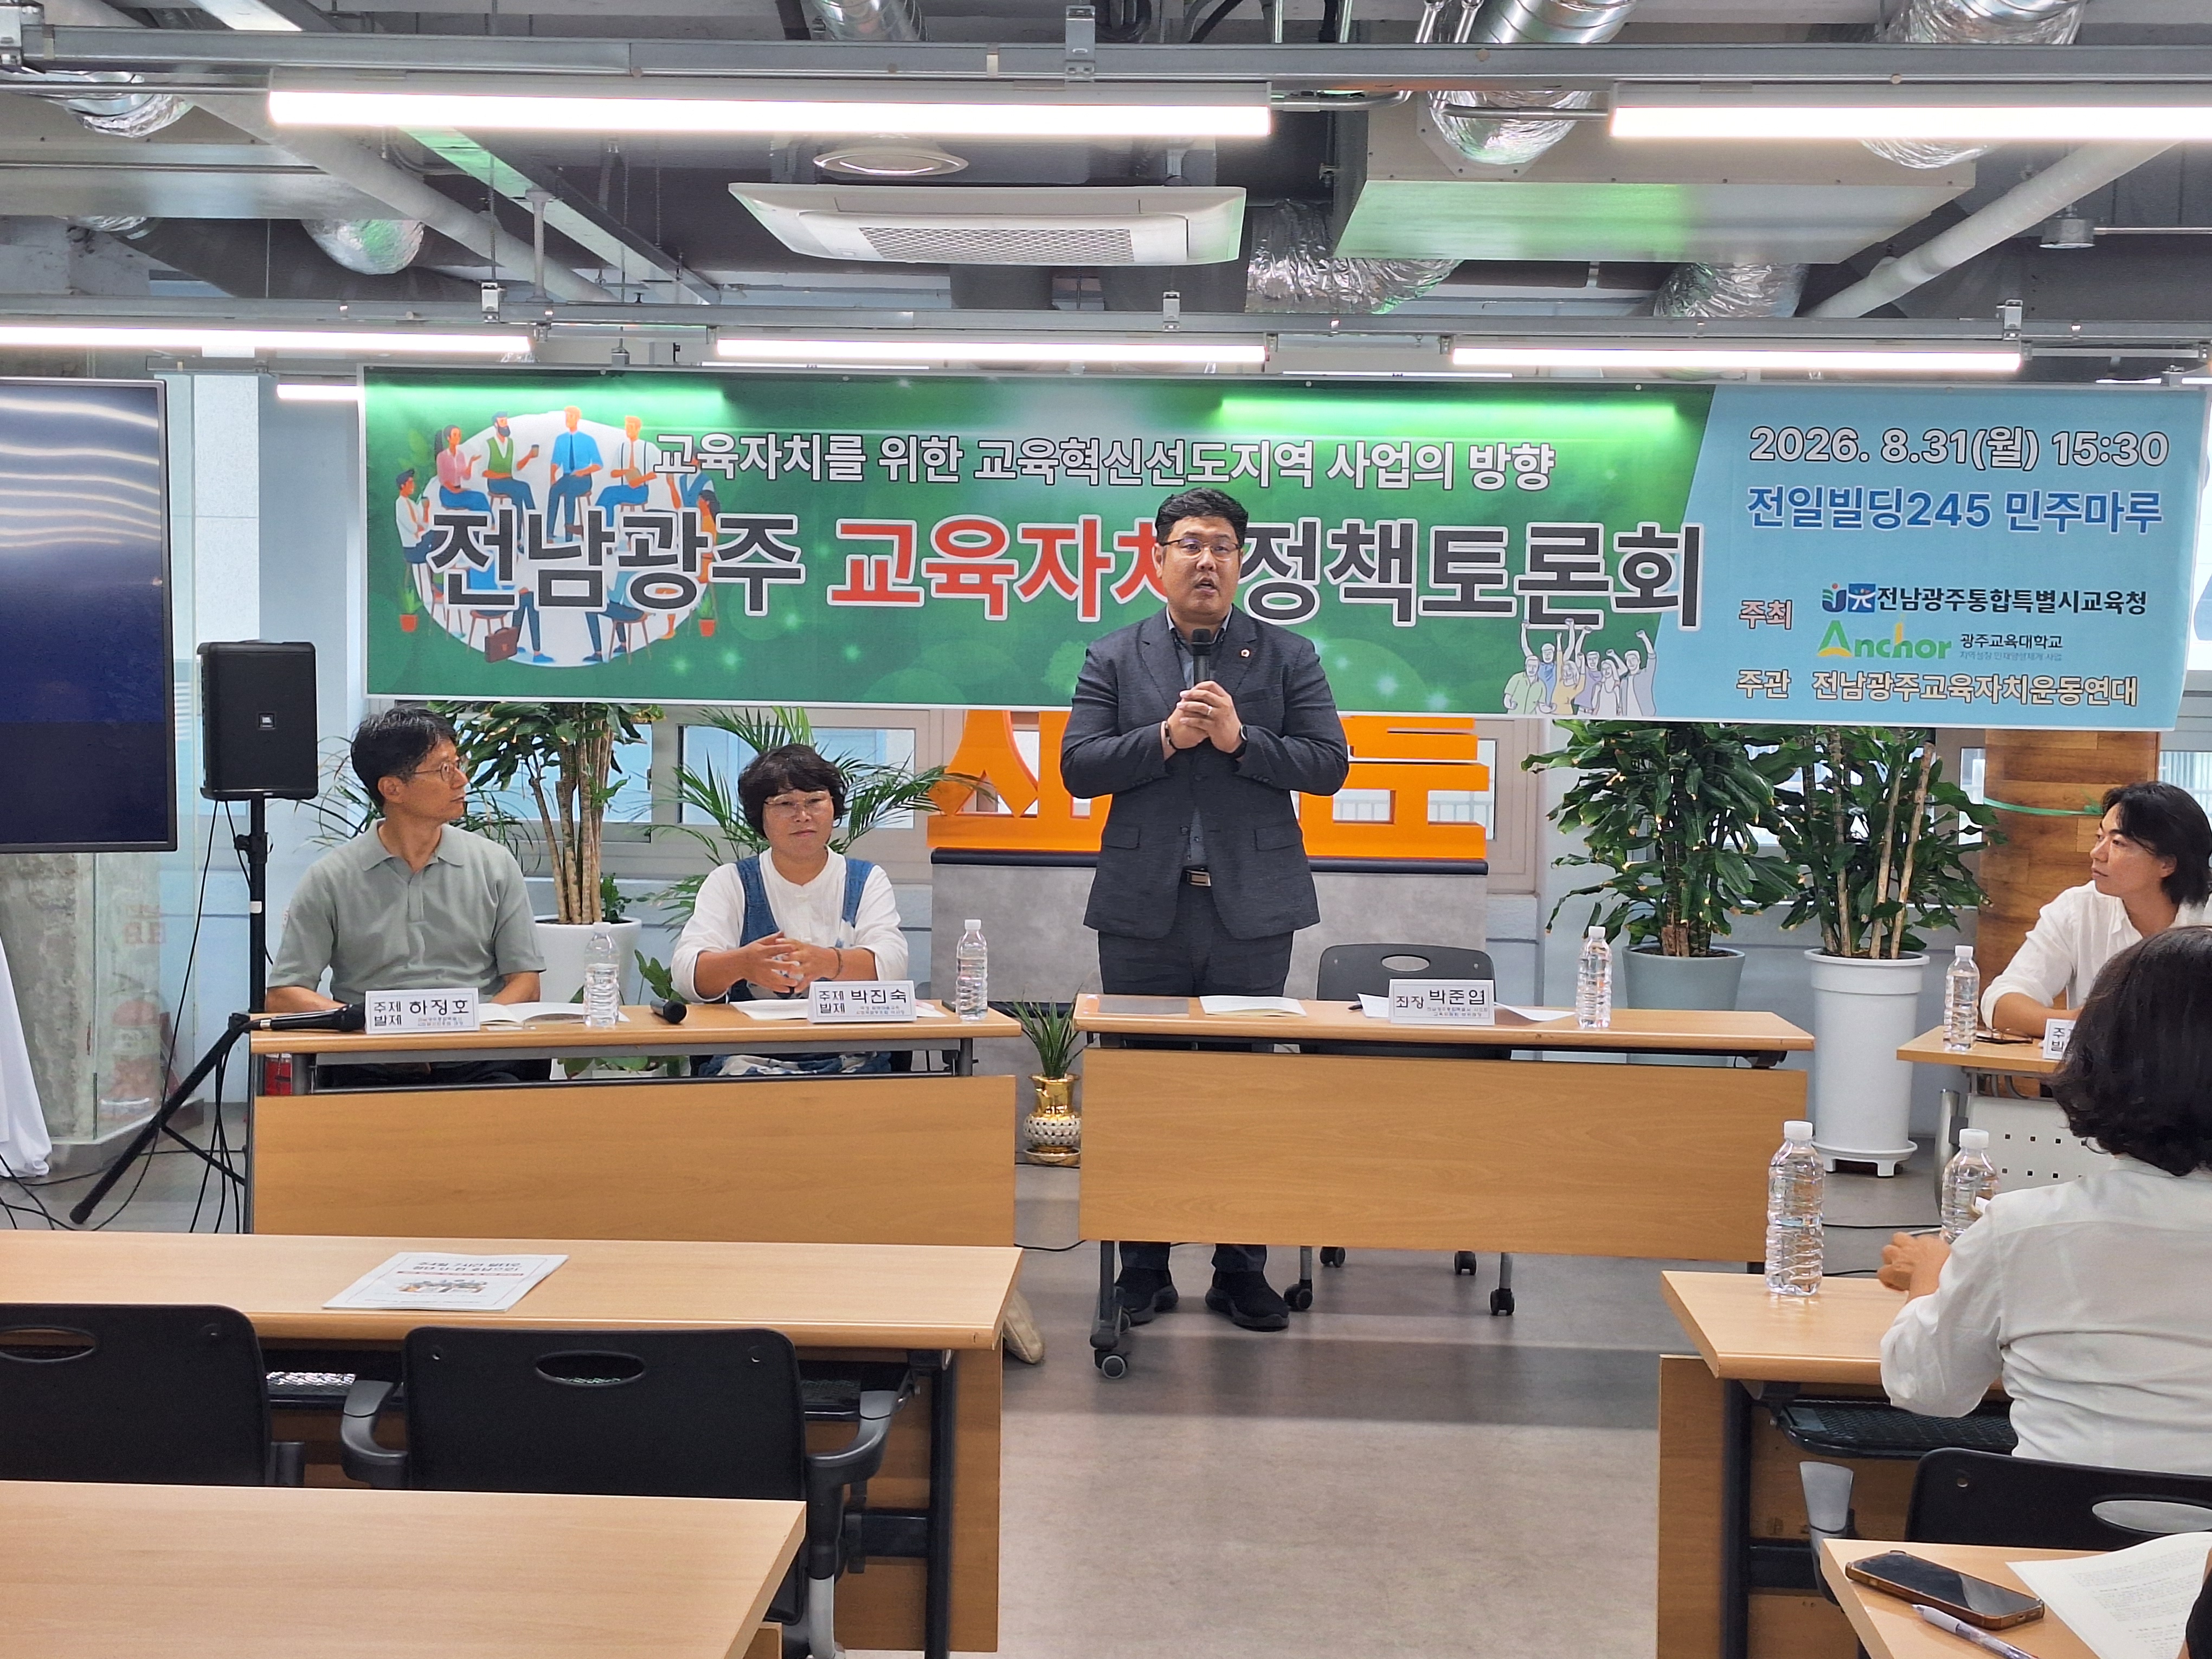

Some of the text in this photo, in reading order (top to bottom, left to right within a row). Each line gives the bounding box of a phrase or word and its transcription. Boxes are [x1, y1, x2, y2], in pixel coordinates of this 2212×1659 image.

[652, 433, 1557, 492] 교육자치를 위한 교육혁신선도지역 사업의 방향
[1749, 426, 2170, 470] 2026. 8.31(월) 15:30
[1746, 485, 2165, 534] 전일빌딩245 민주마루
[426, 505, 806, 617] 전남광주
[1237, 516, 1704, 632] 정책토론회
[1738, 599, 1793, 631] 주최
[1876, 586, 2147, 615] 전남광주통합특별시교육청
[1817, 617, 1952, 659] Anchor
[1960, 633, 2063, 650] 광주교육대학교
[1736, 669, 2139, 707] 주관 전남광주교육자치운동연대
[374, 1000, 401, 1013] 주제
[409, 999, 470, 1015] 하정호
[819, 990, 845, 1001] 주제
[820, 1002, 846, 1014] 발제
[851, 989, 907, 1004] 박진숙
[374, 1014, 402, 1026] 발제
